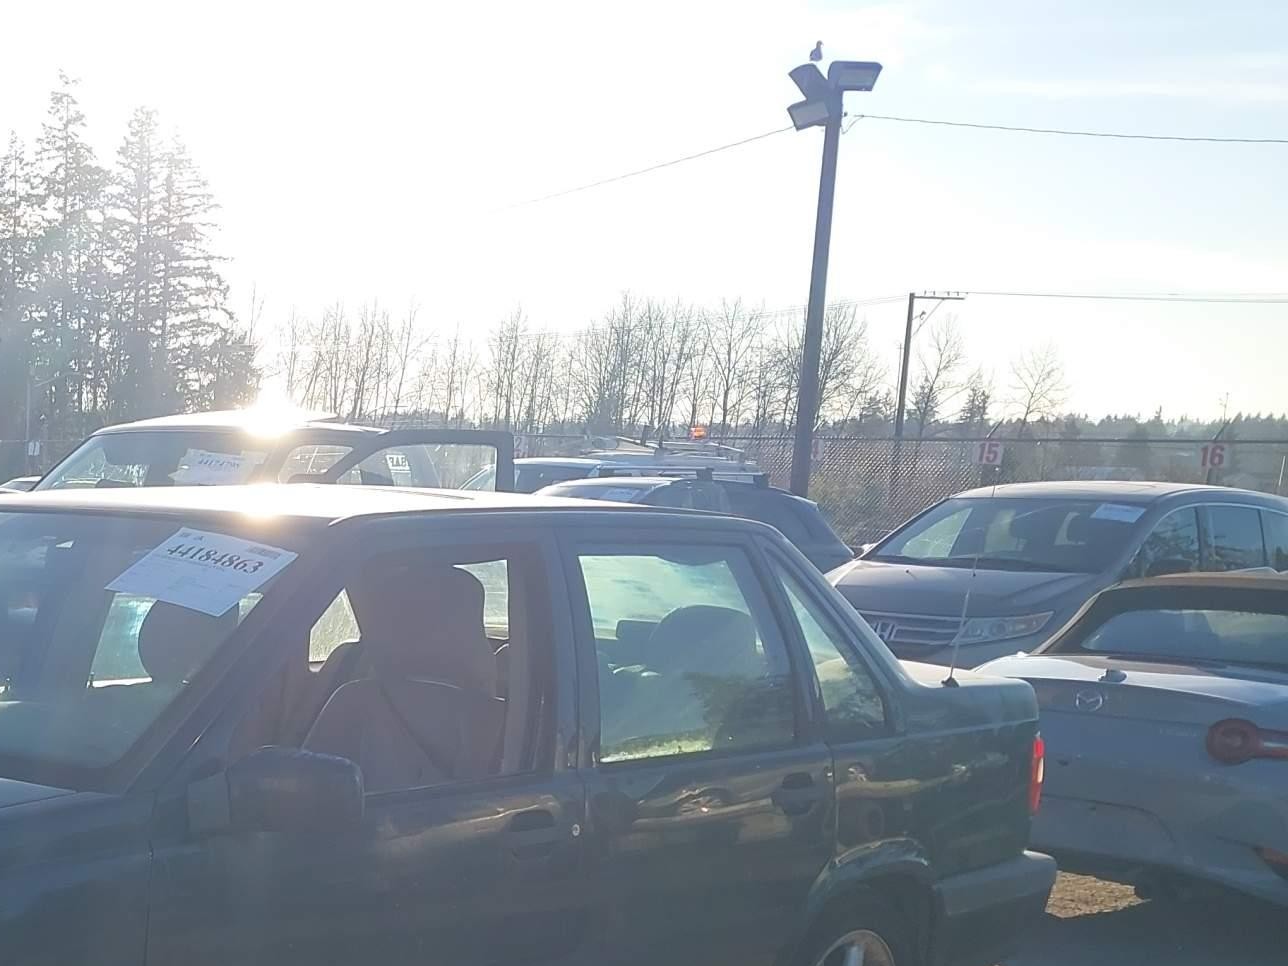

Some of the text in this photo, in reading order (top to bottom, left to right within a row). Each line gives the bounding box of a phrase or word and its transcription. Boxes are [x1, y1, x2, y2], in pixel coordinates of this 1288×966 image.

[977, 442, 1000, 463] 15
[1201, 445, 1225, 467] 16
[166, 543, 264, 574] 44184863
